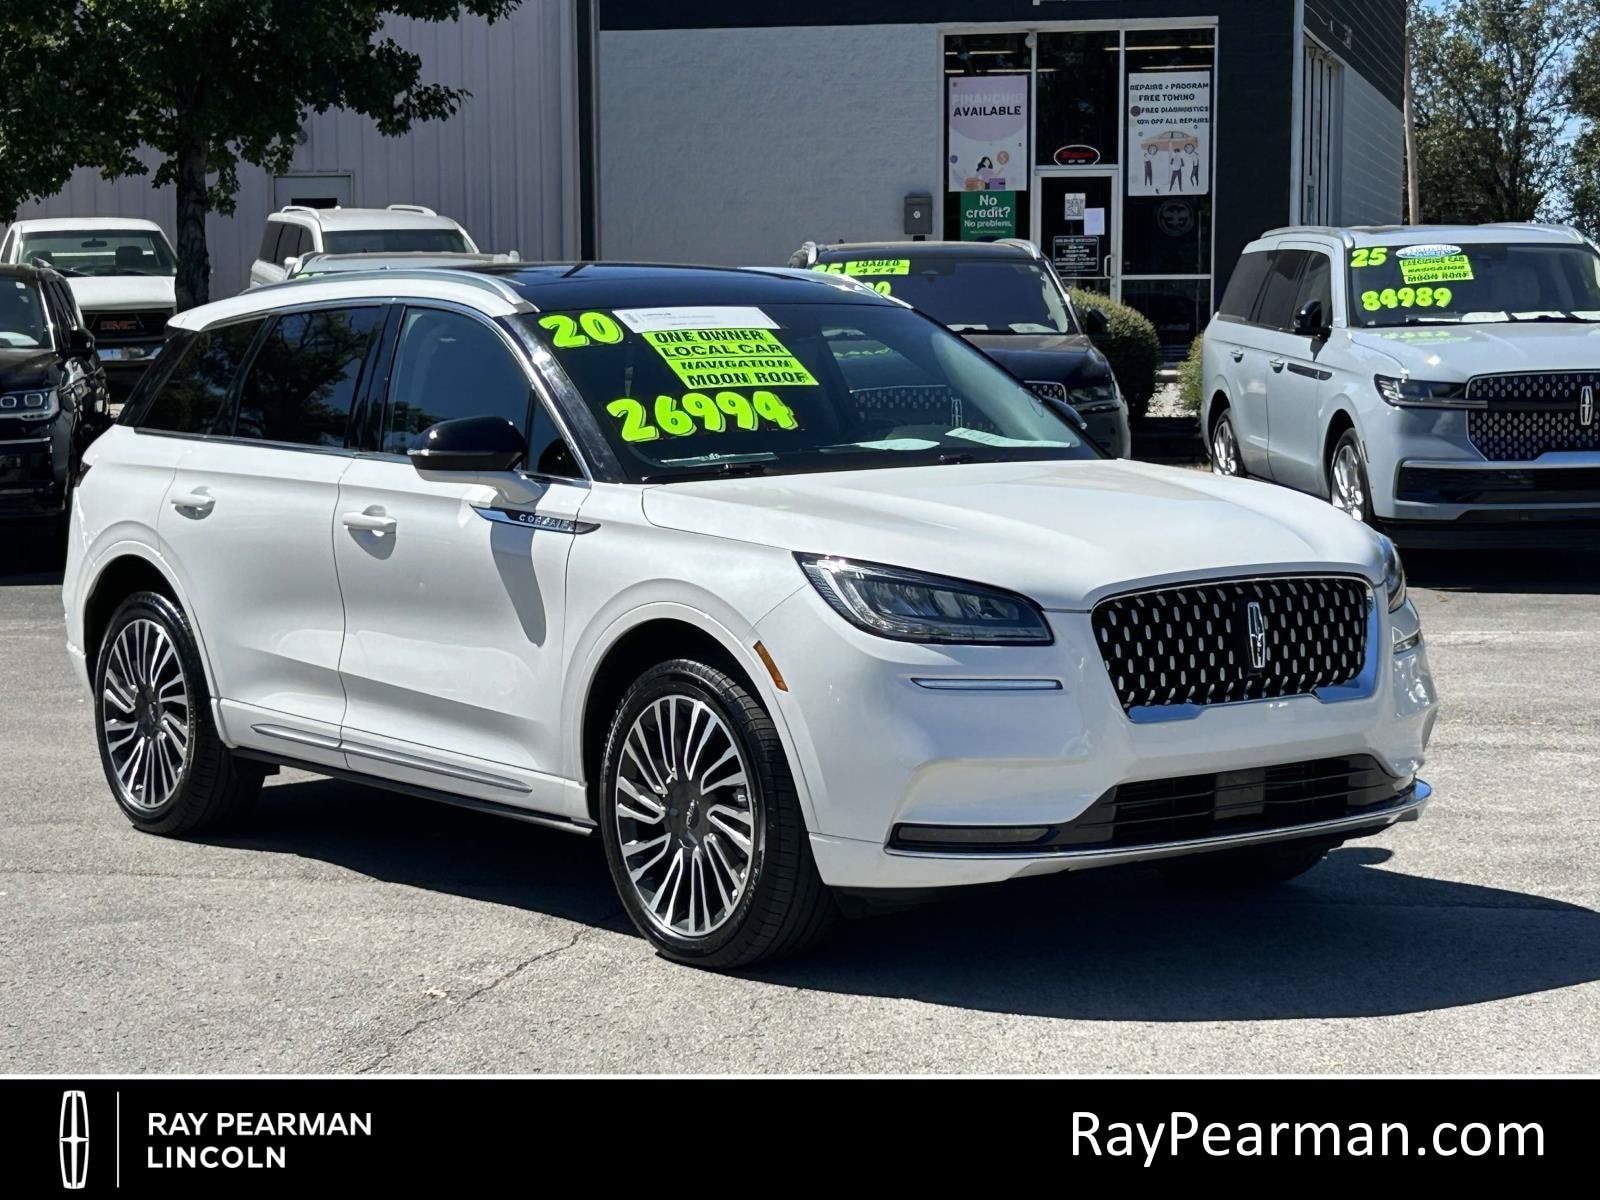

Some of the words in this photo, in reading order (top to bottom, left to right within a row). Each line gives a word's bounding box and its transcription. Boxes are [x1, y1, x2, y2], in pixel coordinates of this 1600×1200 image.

[953, 106, 1022, 117] AVAILABLE
[979, 194, 998, 206] No
[965, 206, 1011, 219] credit?
[964, 220, 976, 228] No
[977, 219, 1012, 229] problem.
[1350, 247, 1388, 268] 25
[1361, 287, 1452, 312] 84989
[539, 312, 624, 348] 20
[654, 331, 695, 344] ONE
[700, 329, 764, 342] OWNER
[661, 345, 736, 358] LOCAL
[739, 343, 784, 355] CAR
[680, 359, 793, 370] NAVIGATION
[687, 373, 750, 387] MOON
[754, 371, 808, 384] ROOF
[606, 391, 799, 443] 26994
